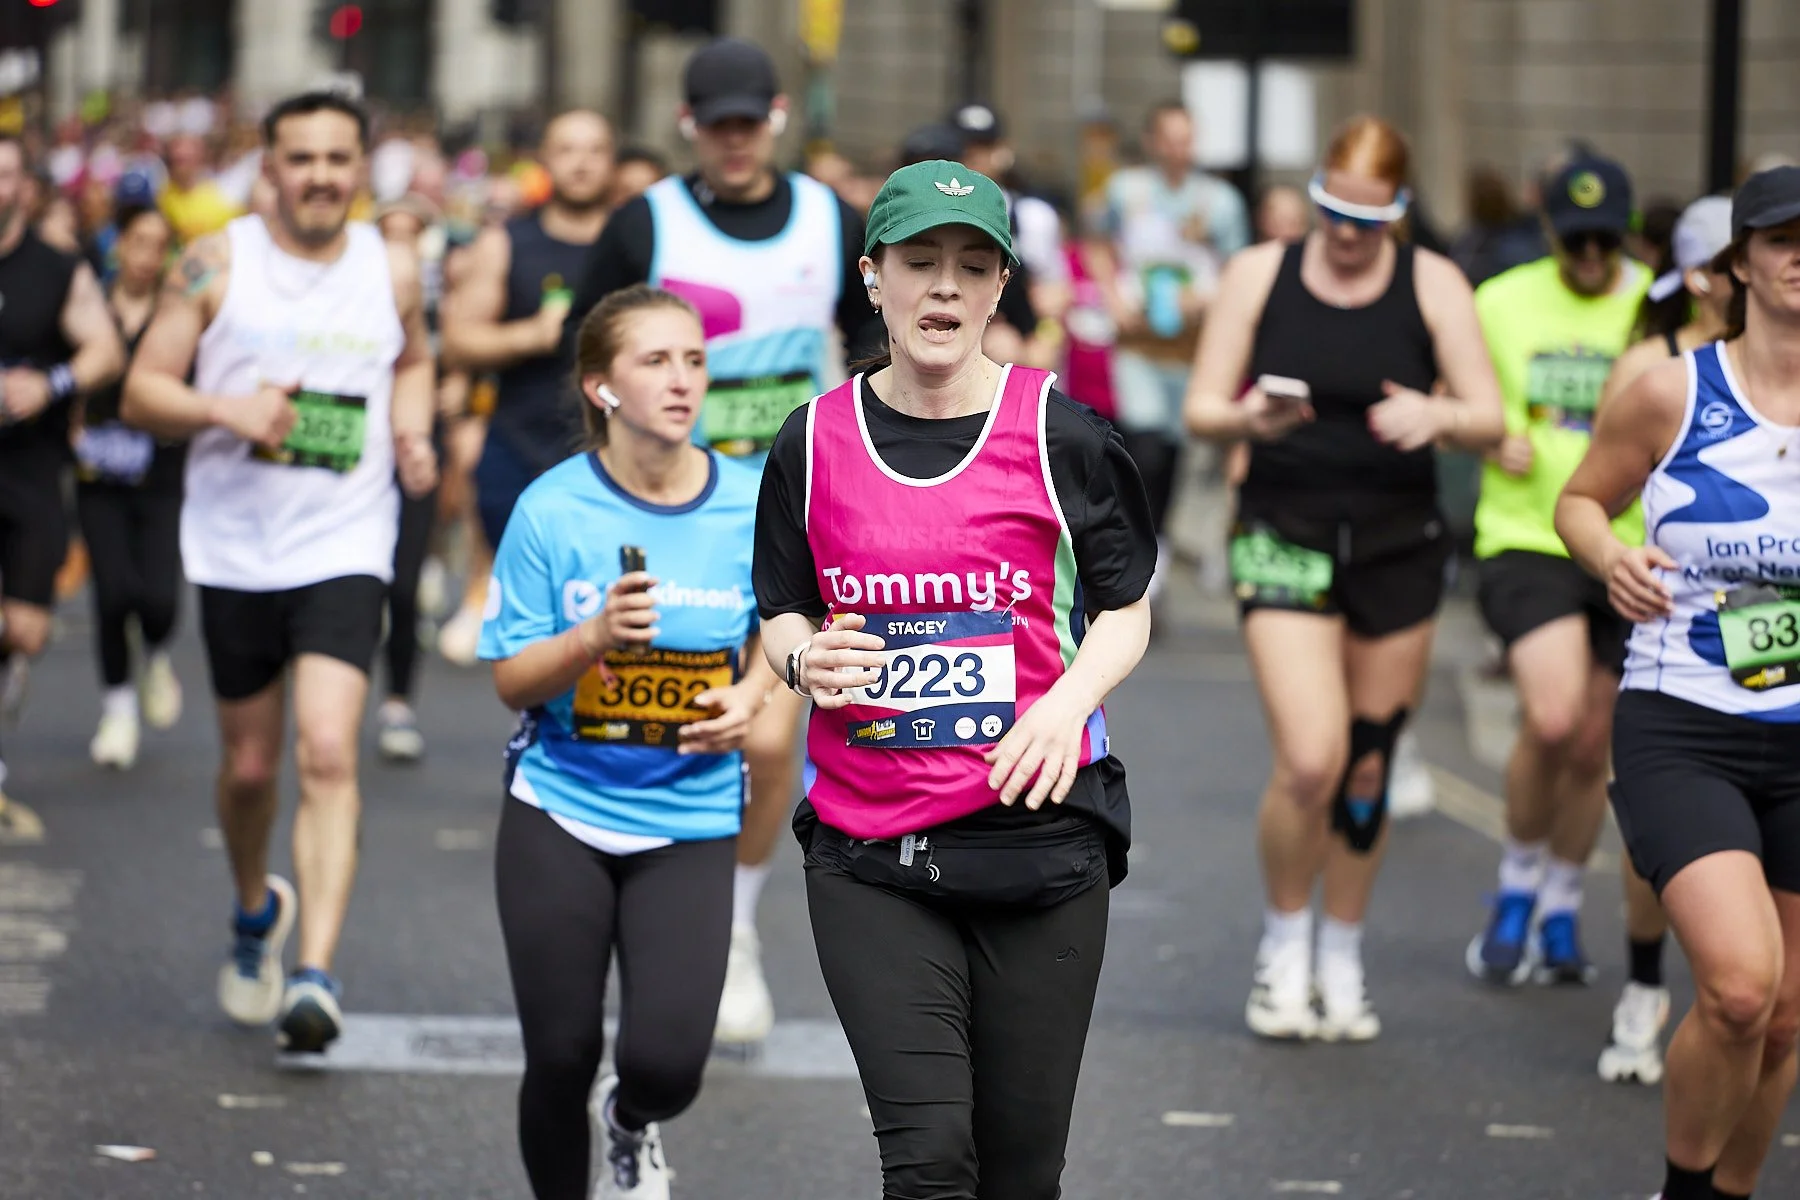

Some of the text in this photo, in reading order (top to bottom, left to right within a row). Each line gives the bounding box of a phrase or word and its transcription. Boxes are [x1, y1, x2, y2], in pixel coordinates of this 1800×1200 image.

[1706, 537, 1750, 558] Ian
[823, 562, 1032, 612] Tommy's
[888, 620, 947, 635] STACEY
[599, 675, 711, 711] 3662
[863, 652, 986, 699] 9223
